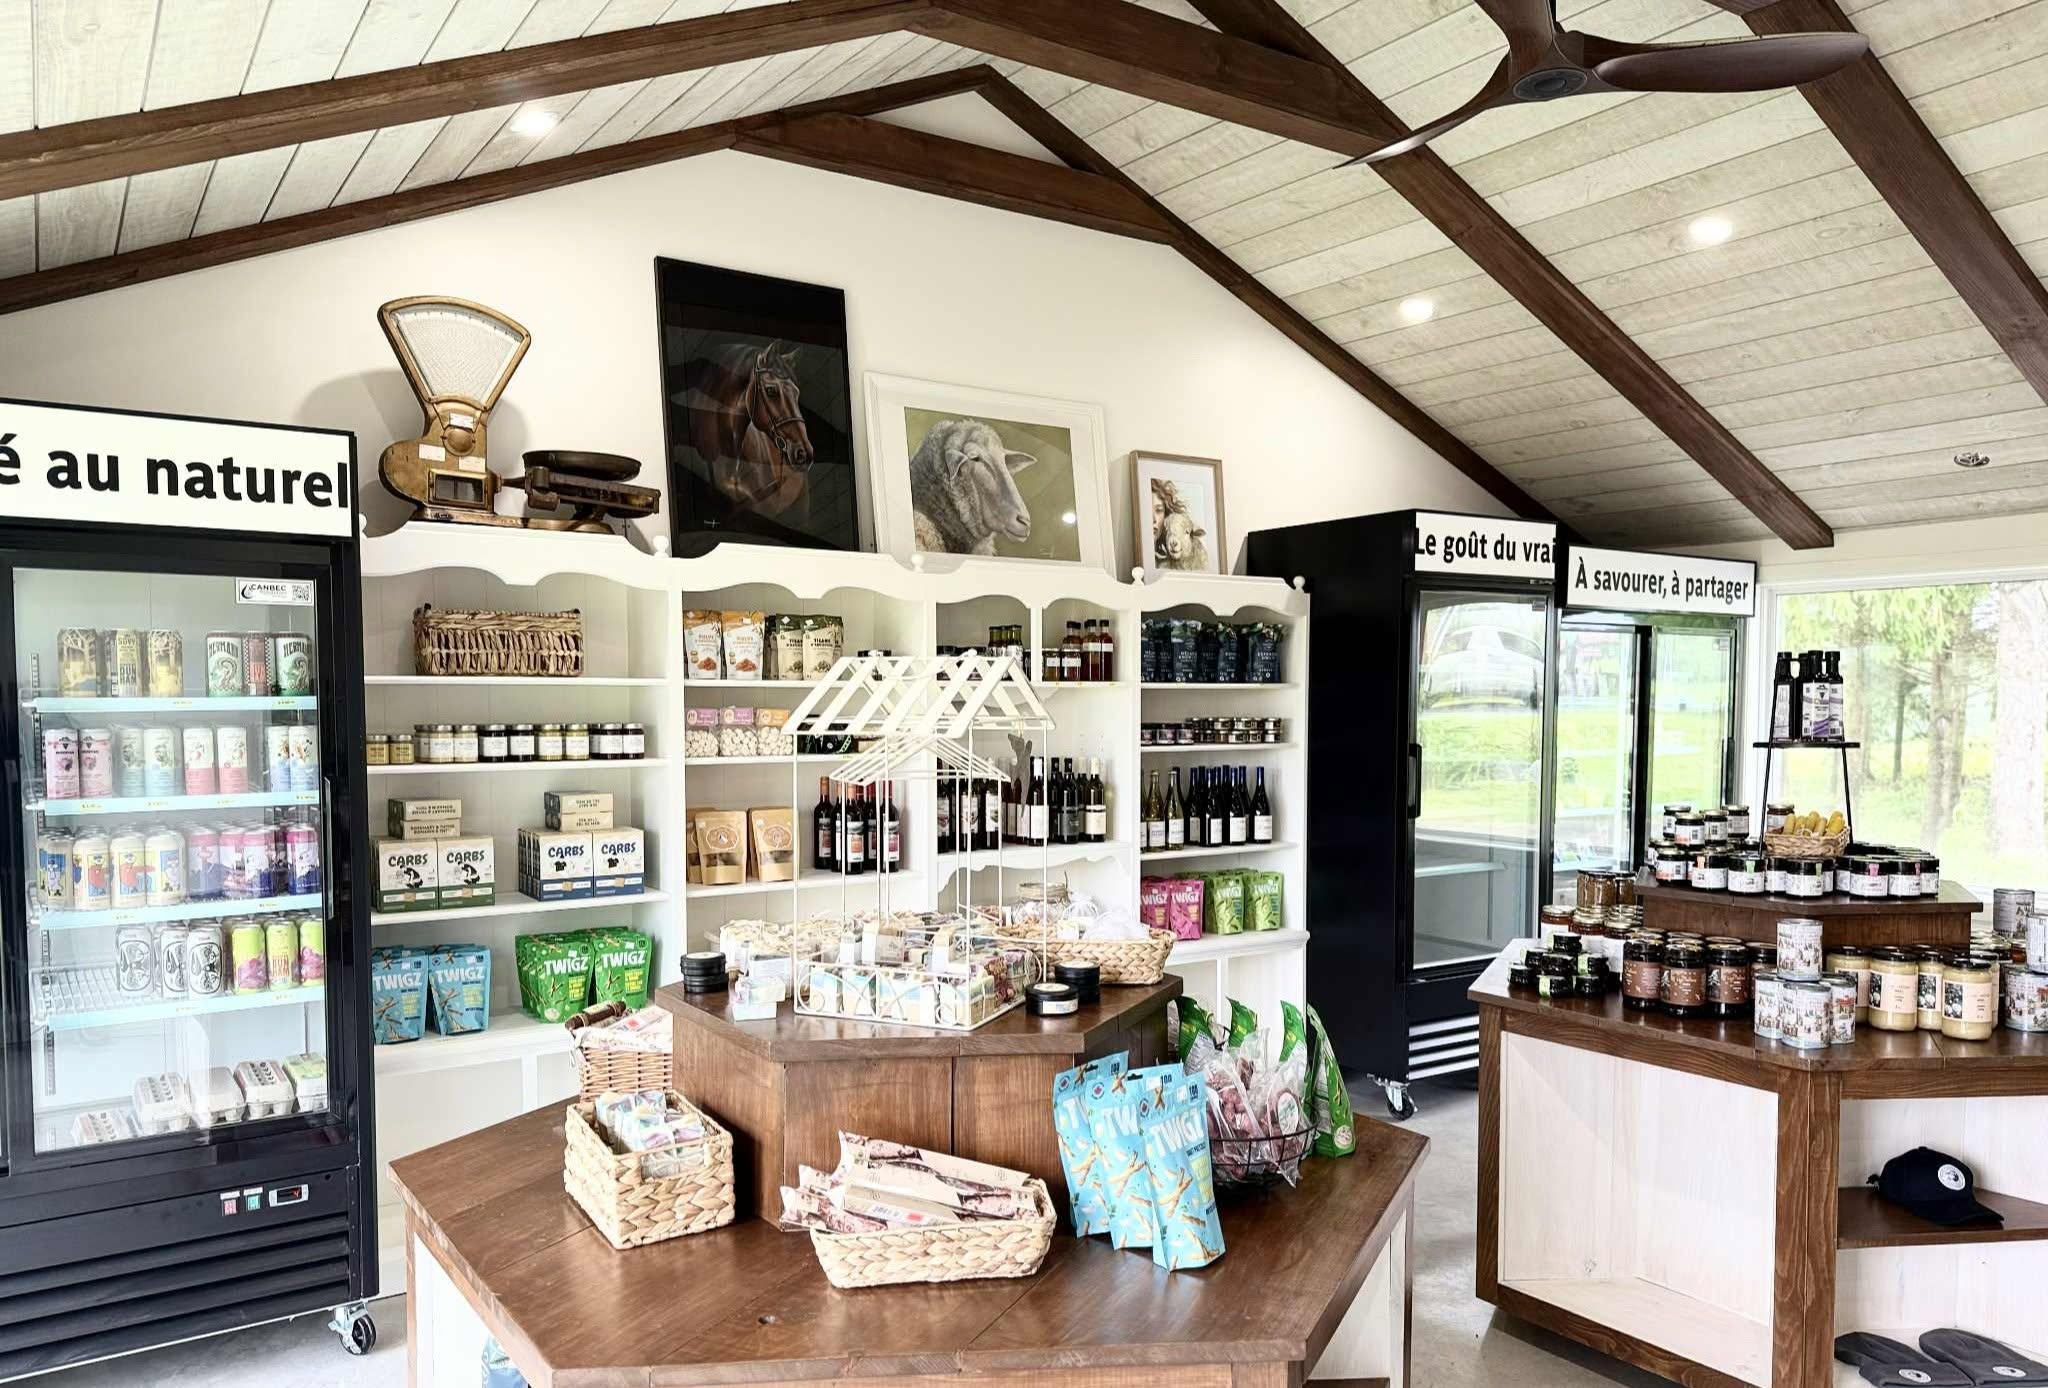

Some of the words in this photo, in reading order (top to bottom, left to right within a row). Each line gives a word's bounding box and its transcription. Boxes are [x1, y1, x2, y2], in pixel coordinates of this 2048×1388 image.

[47, 450, 120, 492] au
[147, 457, 349, 508] naturel
[1415, 527, 1437, 555] Le
[1443, 531, 1488, 563] goût
[1494, 533, 1516, 561] du
[1523, 537, 1557, 563] vrai
[1575, 556, 1588, 589] À
[1594, 569, 1667, 599] savourer,
[1671, 570, 1680, 596] à
[1686, 576, 1749, 605] partager
[446, 849, 485, 864] CARBS
[548, 845, 584, 858] CARBS
[601, 842, 636, 855] CARBS
[388, 853, 428, 868] CARBS
[544, 956, 589, 977] TWIGZ
[601, 951, 646, 969] TWIGZ
[372, 972, 422, 992] TWIGZ
[434, 965, 486, 985] TWIGZ
[1149, 1105, 1205, 1158] TWIGZ
